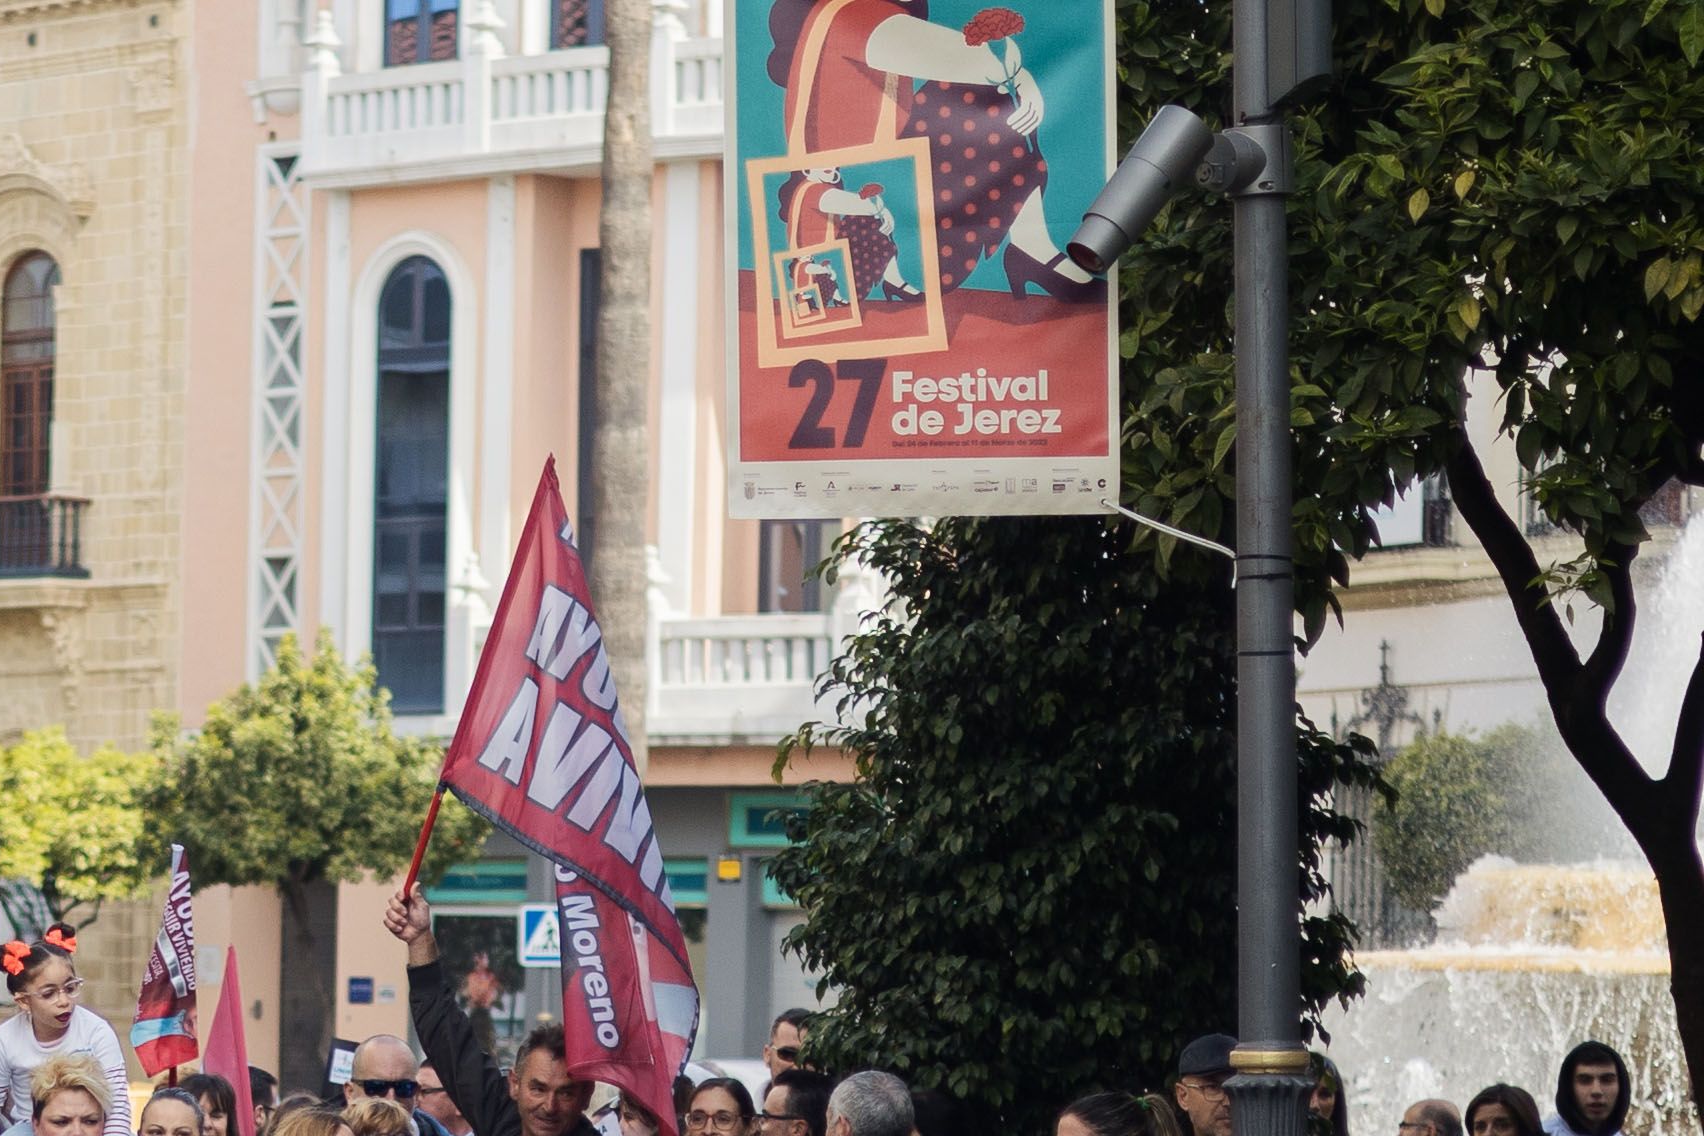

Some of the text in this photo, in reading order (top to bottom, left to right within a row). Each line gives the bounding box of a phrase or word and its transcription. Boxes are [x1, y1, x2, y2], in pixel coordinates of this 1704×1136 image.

[787, 358, 888, 449] 27
[891, 367, 1049, 404] Festival
[891, 403, 1063, 437] de Jerez
[561, 894, 620, 1049] Moreno
